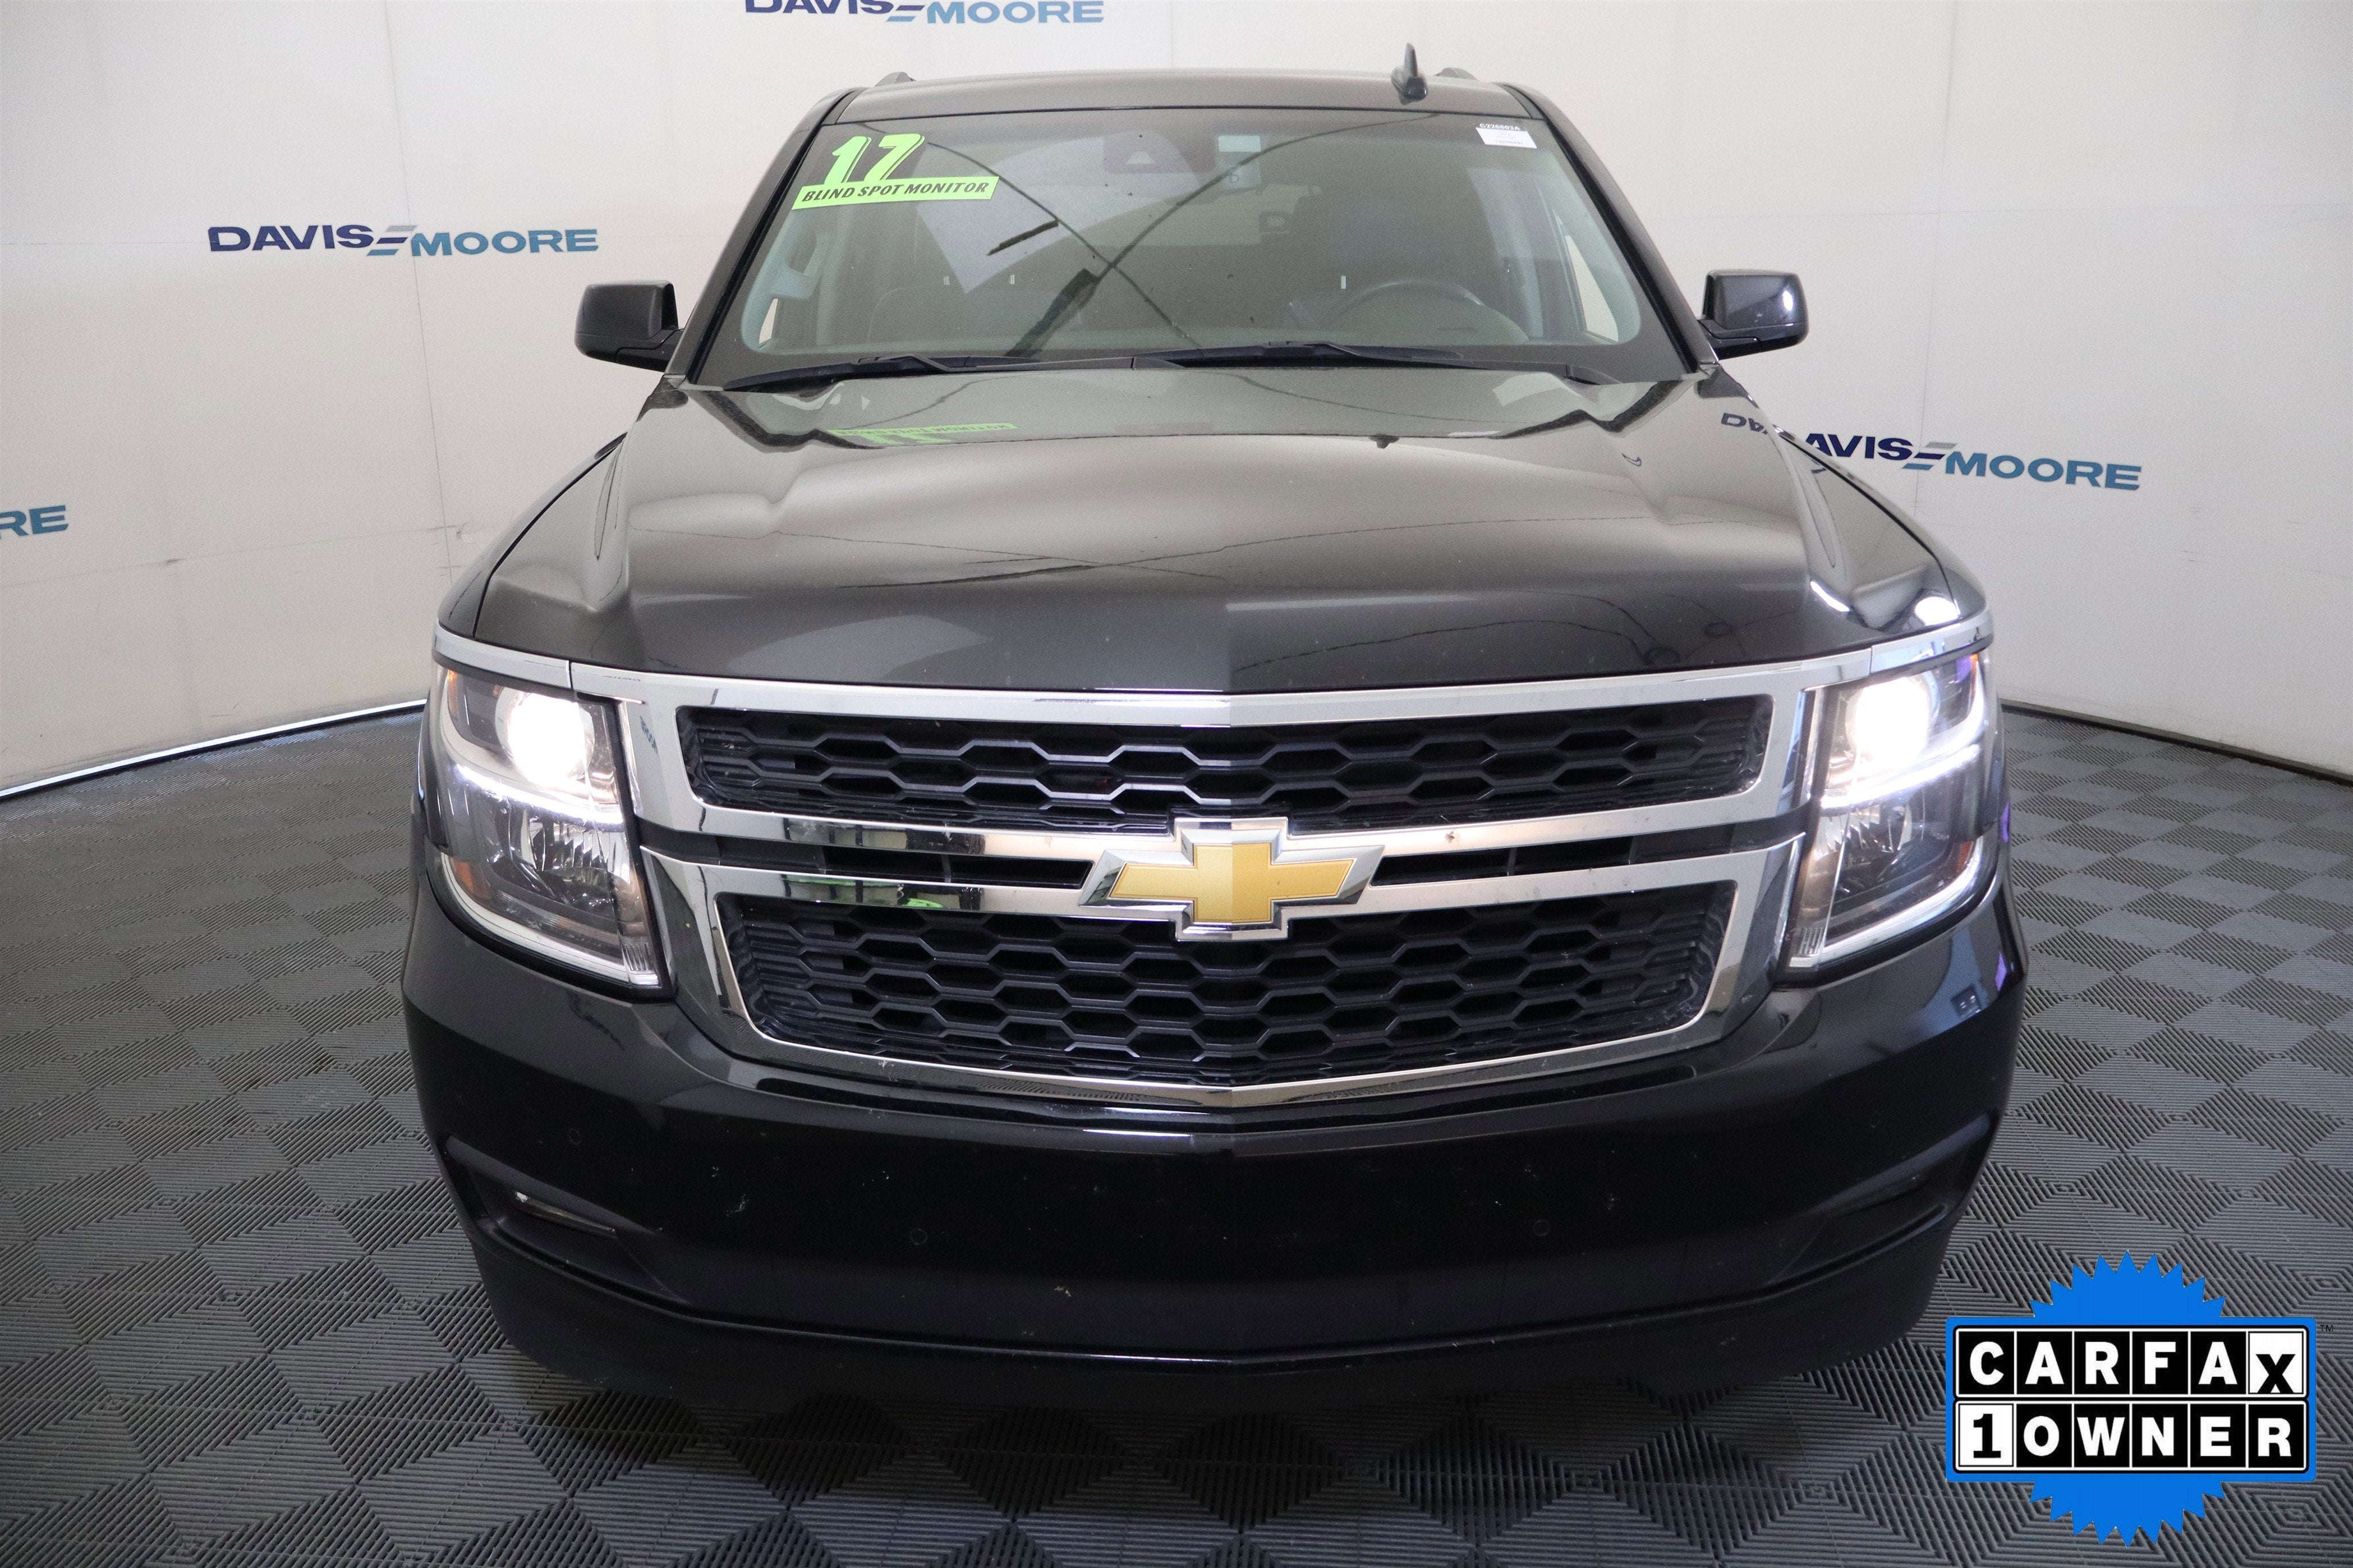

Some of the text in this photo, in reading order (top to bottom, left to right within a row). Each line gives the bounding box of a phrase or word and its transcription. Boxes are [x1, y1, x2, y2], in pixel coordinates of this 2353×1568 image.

[927, 1, 1104, 24] MOORE
[824, 133, 925, 185] 17
[801, 183, 989, 202] BLIND SPOT MONITOR
[207, 225, 599, 257] DAVIS MOORE
[1804, 432, 2142, 491] AVIS MOORE
